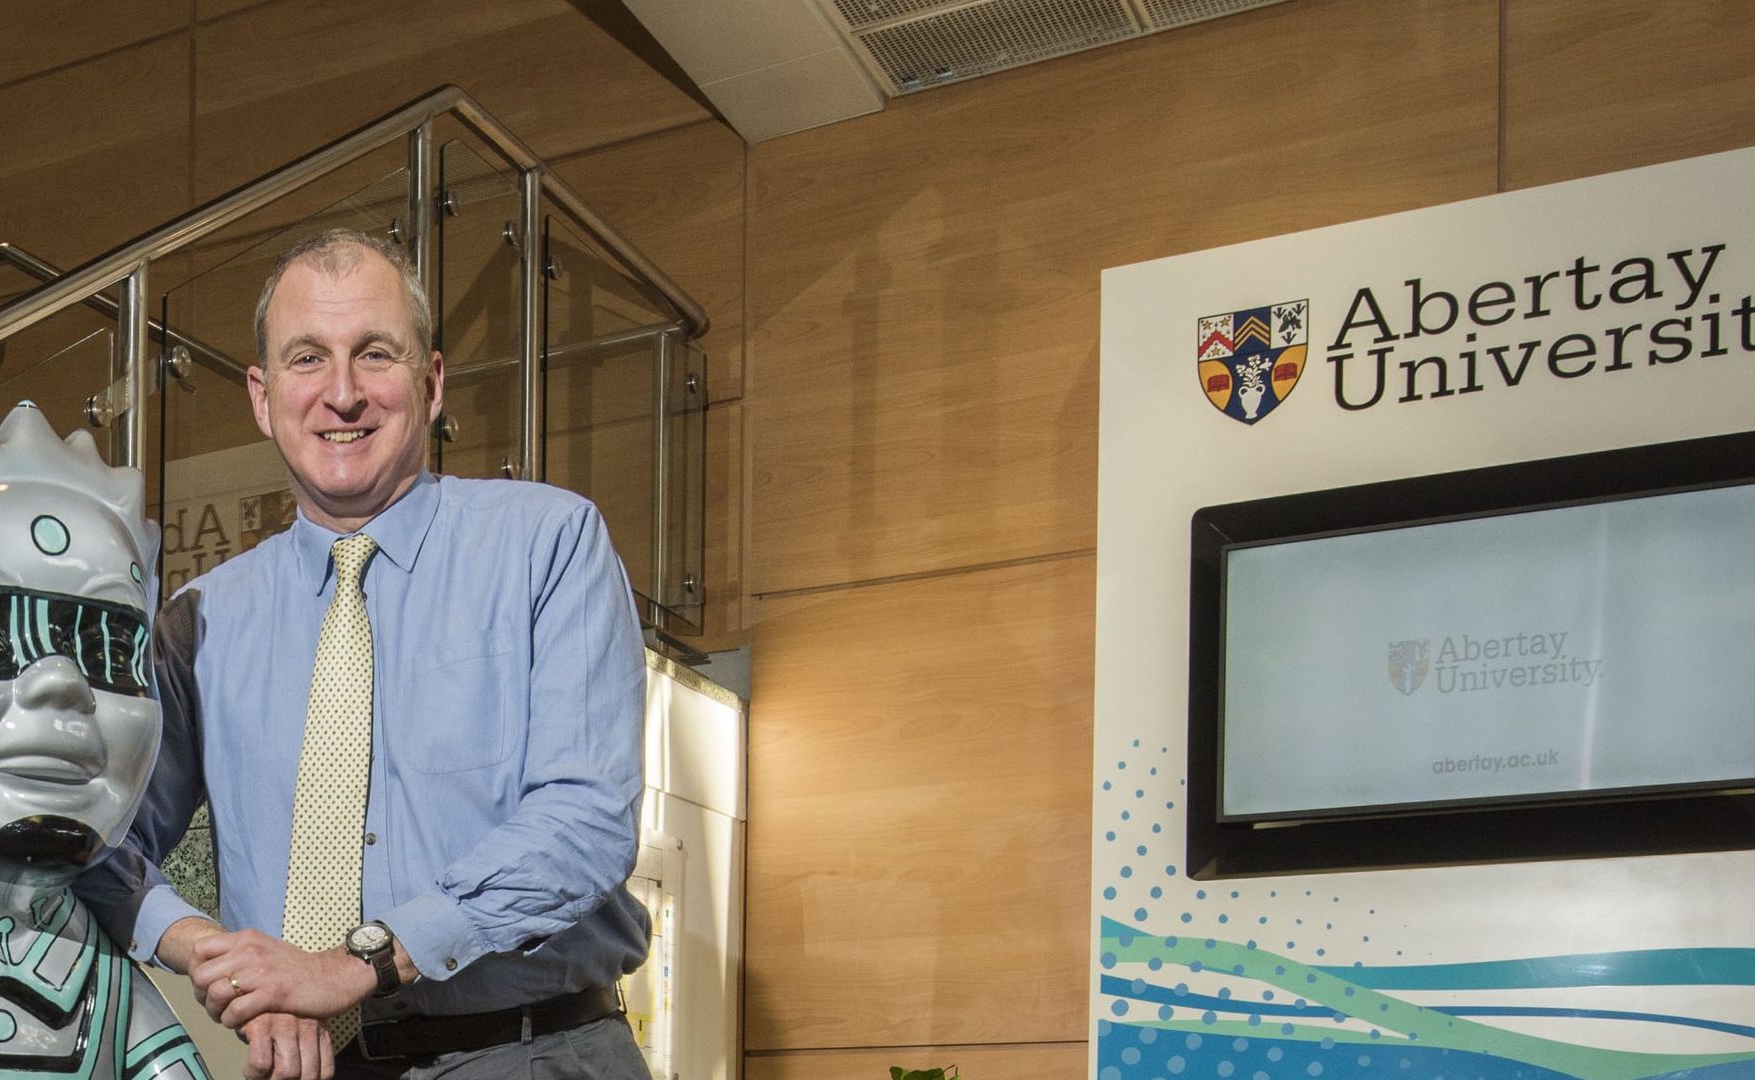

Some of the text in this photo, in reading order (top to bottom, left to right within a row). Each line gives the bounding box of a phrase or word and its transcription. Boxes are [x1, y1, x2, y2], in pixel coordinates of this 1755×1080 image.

[1327, 243, 1726, 351] Abertay
[1435, 631, 1568, 664] Abertay
[1431, 748, 1559, 774] abertay.ac.uk
